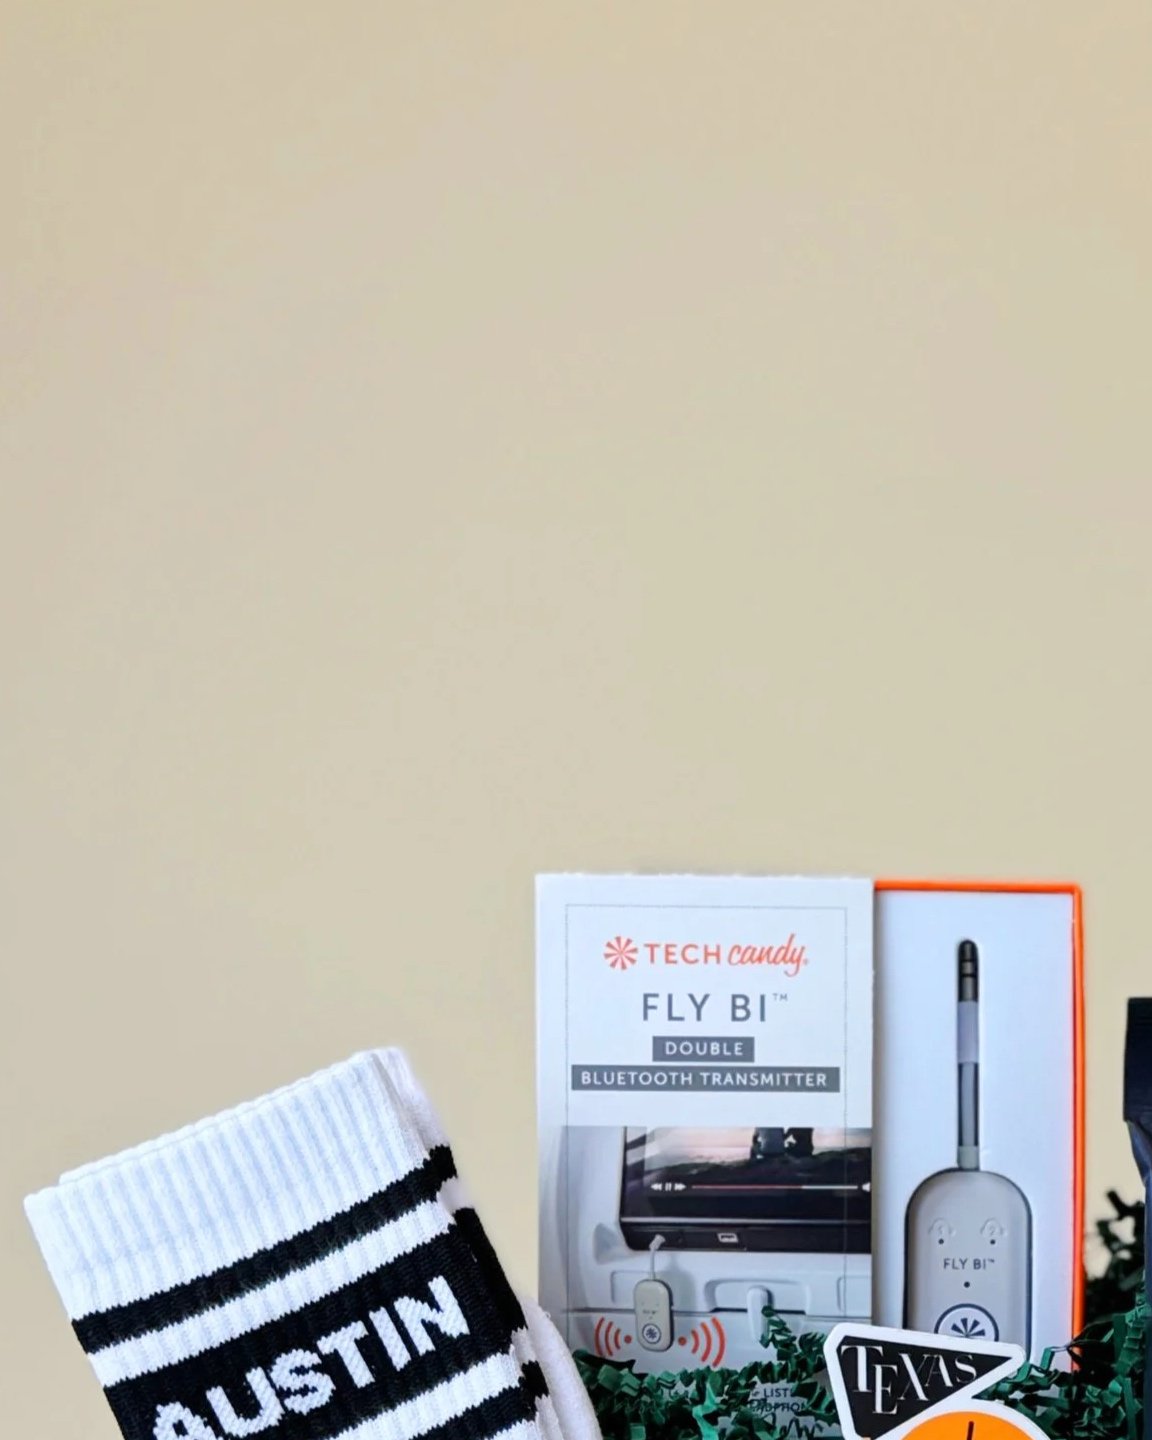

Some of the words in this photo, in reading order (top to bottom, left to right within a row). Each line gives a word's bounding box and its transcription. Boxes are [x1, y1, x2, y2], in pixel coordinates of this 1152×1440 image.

[644, 943, 720, 964] TECH
[643, 993, 710, 1022] FLY
[665, 1041, 743, 1056] DOUBLE
[581, 1071, 692, 1086] BLUETOOTH
[700, 1072, 827, 1087] TRANSMITTER
[943, 1258, 968, 1270] FLY
[841, 1345, 977, 1415] TEXAS
